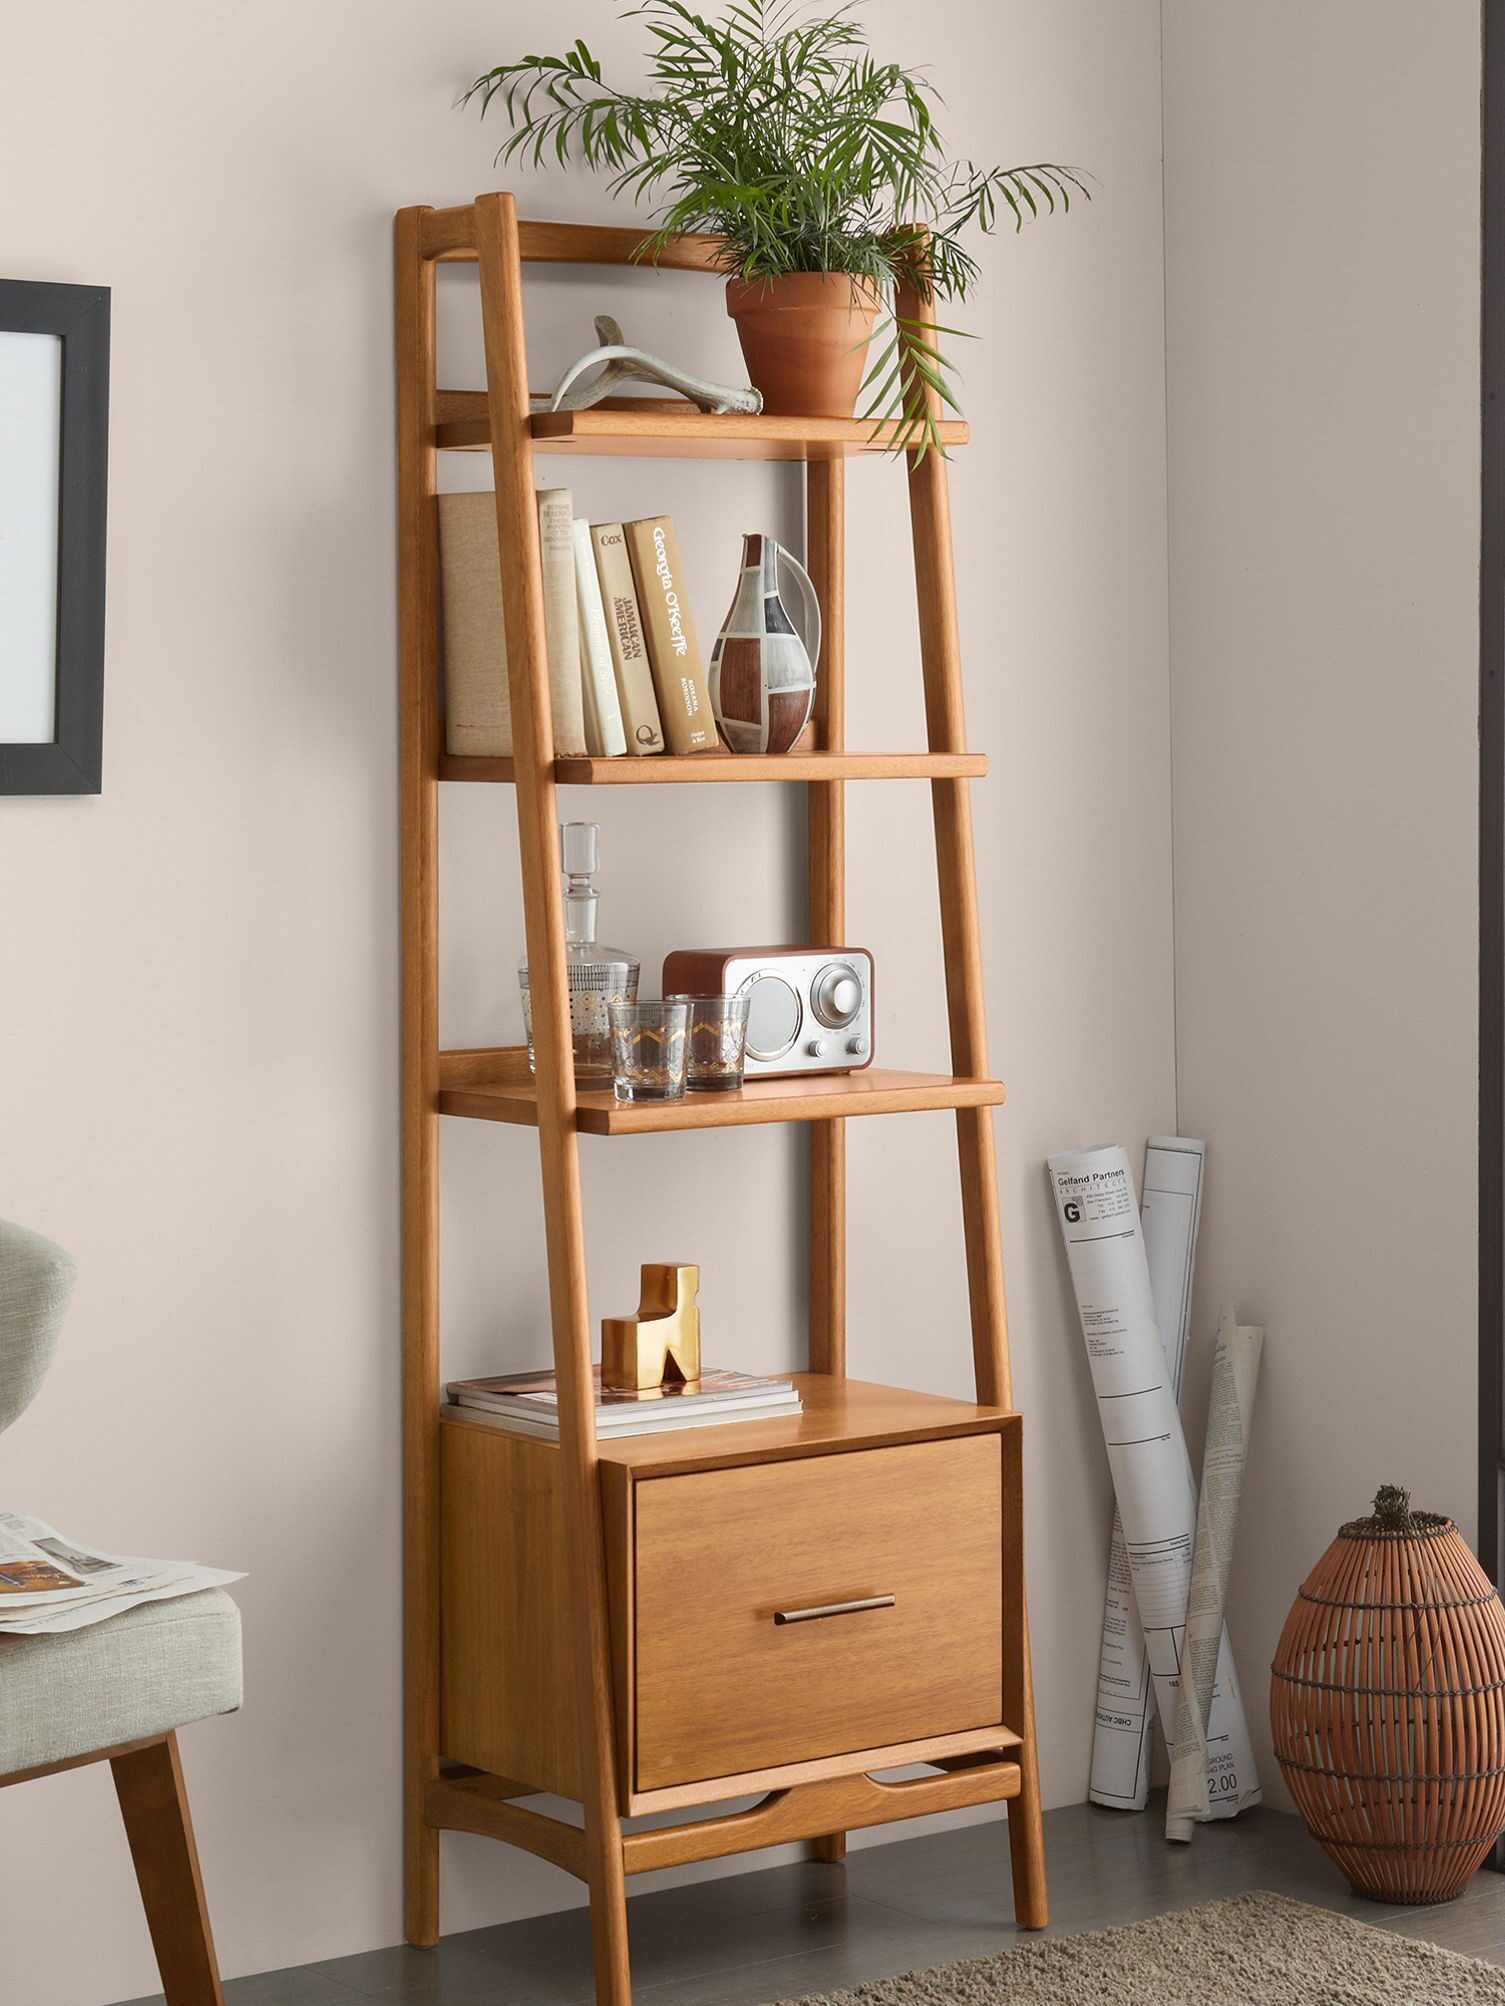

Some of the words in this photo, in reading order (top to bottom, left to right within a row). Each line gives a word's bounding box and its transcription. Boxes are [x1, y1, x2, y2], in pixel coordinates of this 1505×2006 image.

[601, 533, 622, 547] Cox
[652, 527, 674, 590] Georgia
[665, 591, 687, 656] O'Keeffe
[613, 597, 633, 661] AMERICAN
[623, 597, 642, 659] JAMAICAN
[680, 677, 694, 717] ROBINSON
[1058, 1175, 1090, 1186] Gelfand
[1092, 1169, 1125, 1181] Partners
[1063, 1202, 1081, 1223] G
